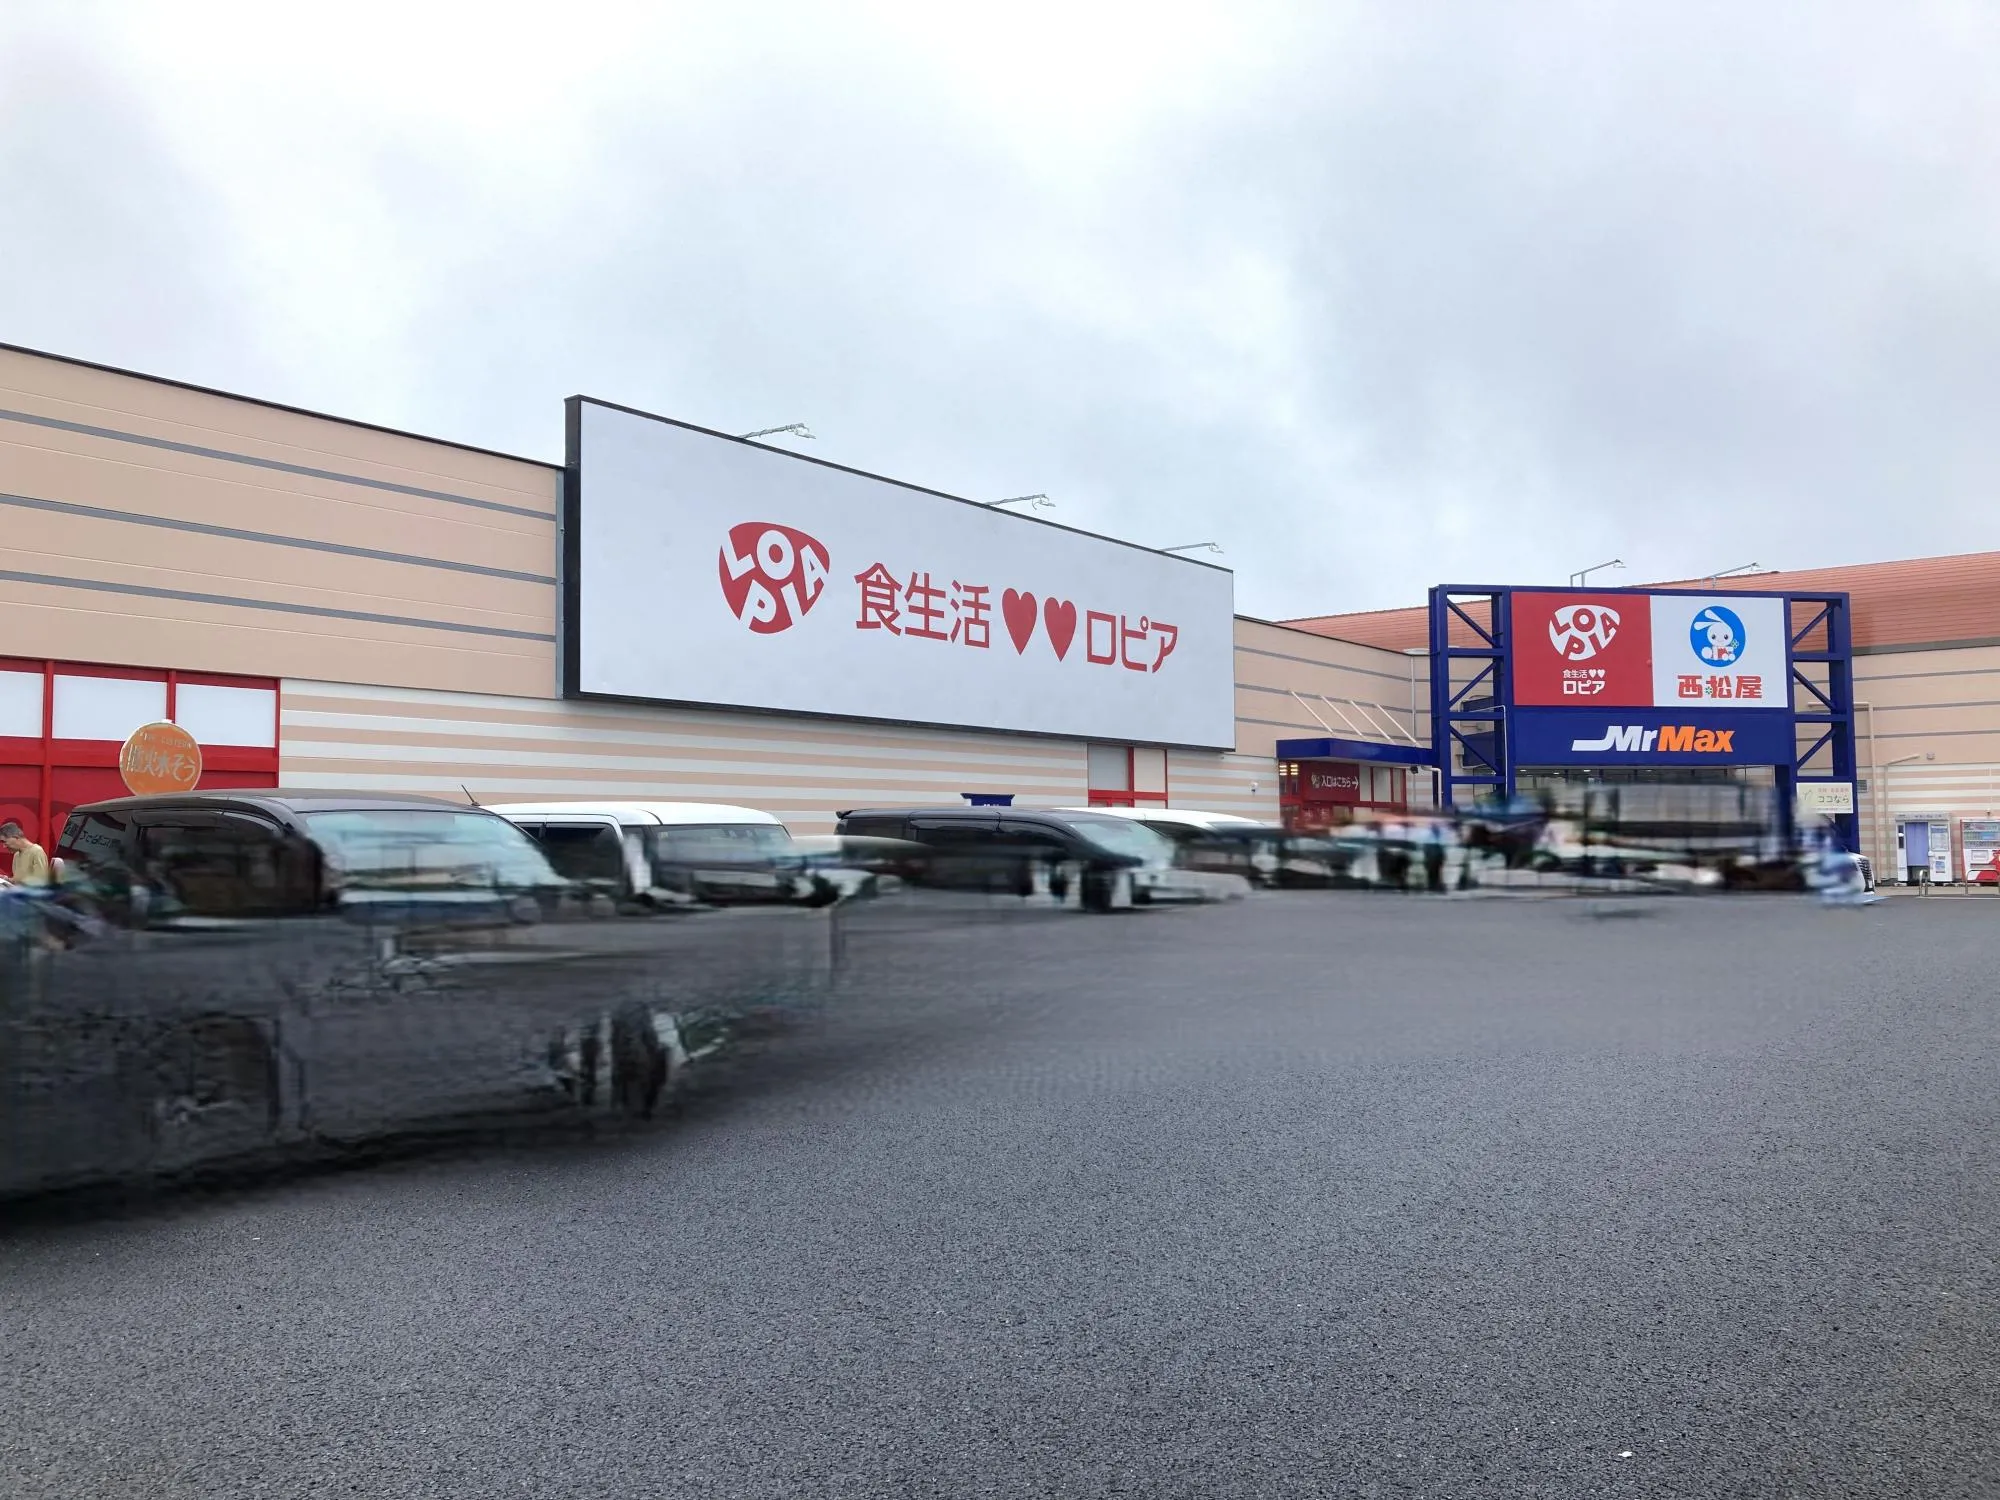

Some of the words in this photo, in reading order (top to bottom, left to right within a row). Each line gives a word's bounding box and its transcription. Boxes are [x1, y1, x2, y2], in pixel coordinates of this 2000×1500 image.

[854, 563, 992, 649] 食生活
[1086, 609, 1178, 673] ロピア
[1563, 669, 1588, 679] 食生活
[1563, 680, 1606, 695] ロピア
[1677, 675, 1763, 699] 西松屋
[1572, 725, 1735, 752] MrMax
